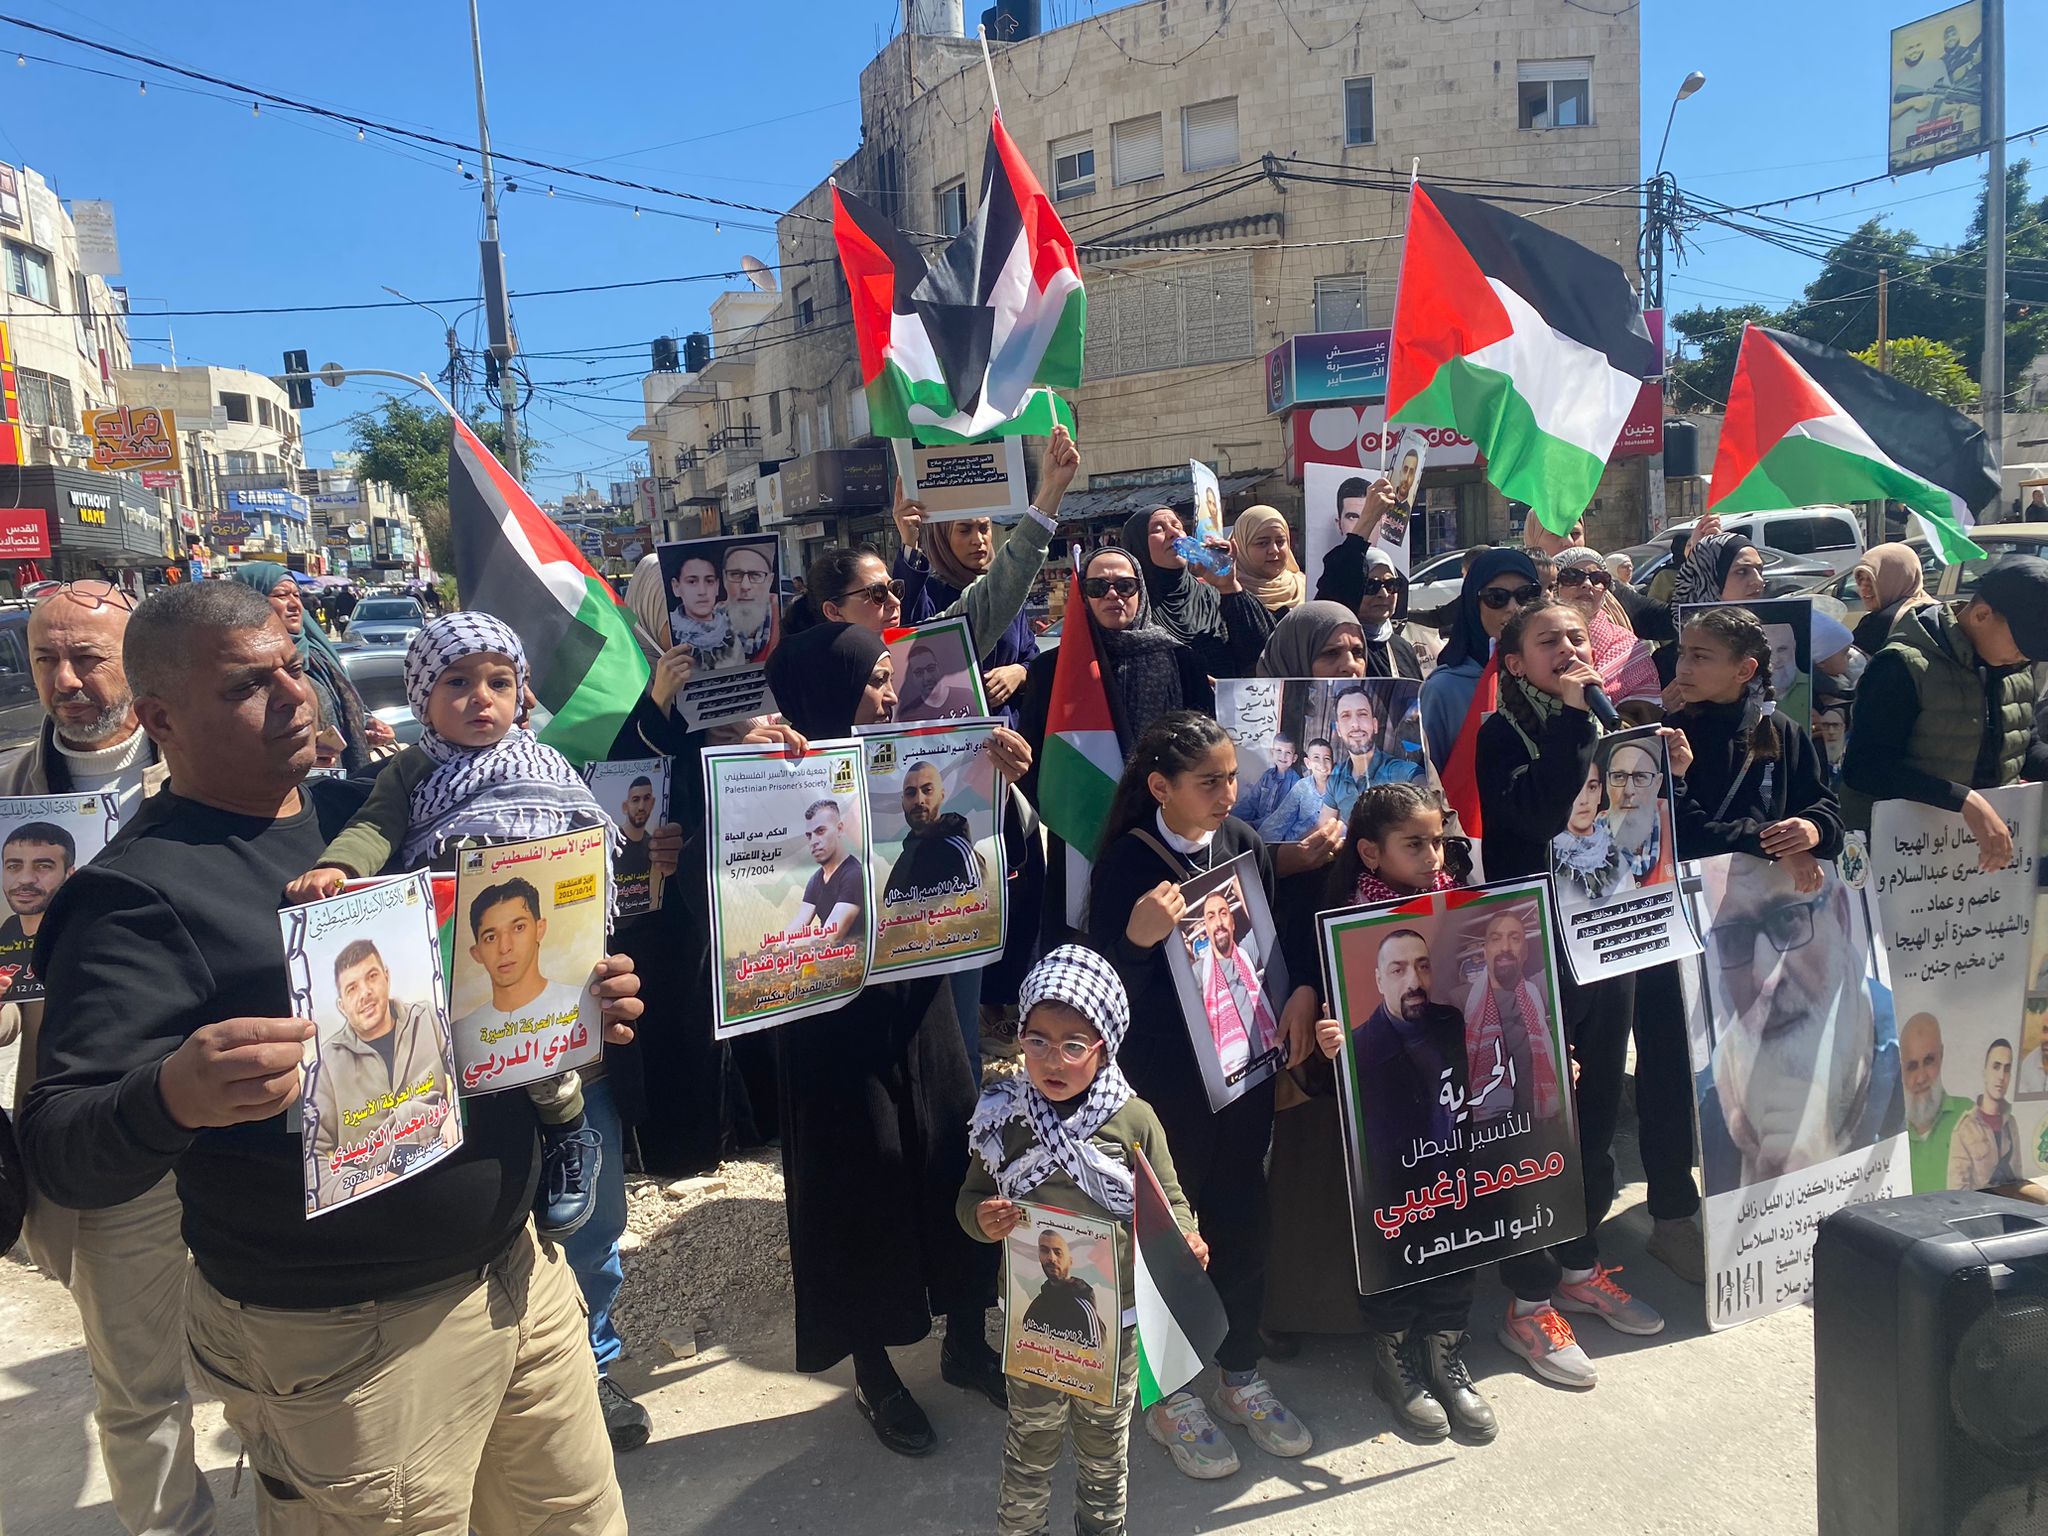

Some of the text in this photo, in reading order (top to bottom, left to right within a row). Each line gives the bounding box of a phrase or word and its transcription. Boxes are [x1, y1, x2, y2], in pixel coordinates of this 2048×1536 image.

[1326, 341, 1386, 360] عيش
[1326, 353, 1385, 371] تجربة
[1326, 366, 1385, 388] الفايبر
[96, 405, 161, 442] فرايد
[1625, 423, 1655, 437] جنين
[94, 438, 172, 464] تشكن
[69, 490, 111, 509] WITHOUT
[79, 508, 106, 525] NAME
[6, 523, 38, 535] القدس
[902, 744, 951, 765] الفلسطيني
[724, 772, 766, 782] الفلسطيني
[807, 768, 828, 777] جمعية
[725, 785, 768, 794] Palestinian
[768, 782, 803, 792] Prisoner's
[803, 780, 828, 789] Society
[724, 832, 746, 843] الحياة
[1894, 832, 1930, 857] الهيجا
[1933, 824, 1948, 855] أبو
[490, 833, 602, 874] نادي الأسير الفلسطيني
[725, 847, 782, 866] تاريخ الاعتقال
[730, 864, 775, 880] 5/7/2004
[1889, 863, 1949, 894] عبدالسلام
[558, 885, 593, 899] 2015/10/14
[1927, 894, 1954, 912] عماد
[1967, 887, 2001, 915] عاصم
[927, 904, 961, 926] مطيع
[1955, 899, 1964, 914] و
[813, 923, 838, 940] الحرية
[878, 909, 927, 937] السعدي
[1895, 914, 2030, 952] والشهيد حمزة أبو الهيجا
[760, 930, 785, 949] البطل
[972, 930, 979, 941] لا
[817, 944, 857, 962] يوسف
[889, 939, 924, 958] ينكسر
[1988, 950, 2005, 969] من
[736, 955, 775, 982] قنديل
[795, 949, 815, 971] نمر
[1920, 958, 1951, 982] جنين
[1953, 954, 1986, 980] مخيم
[754, 988, 786, 1010] ينكسر
[520, 1013, 555, 1035] الحركة
[555, 1003, 580, 1026] شهيد
[463, 1022, 589, 1088] فادي الدربي
[415, 1071, 435, 1097] شهيد
[1439, 1037, 1517, 1124] الحرية
[381, 1084, 415, 1110] الحركة
[328, 1097, 449, 1176] داود محمد الزبيدي
[1401, 1112, 1532, 1168] للأسير البطل
[342, 1170, 369, 1189] 2022
[1797, 1177, 1834, 1204] والكفين
[1373, 1150, 1566, 1240] محمد زغيبي
[1759, 1193, 1783, 1217] الليل
[1780, 1219, 1794, 1241] زرد
[1736, 1228, 1778, 1257] السلاسل
[1775, 1276, 1801, 1303] صلاح
[1015, 1339, 1054, 1353] السعدي
